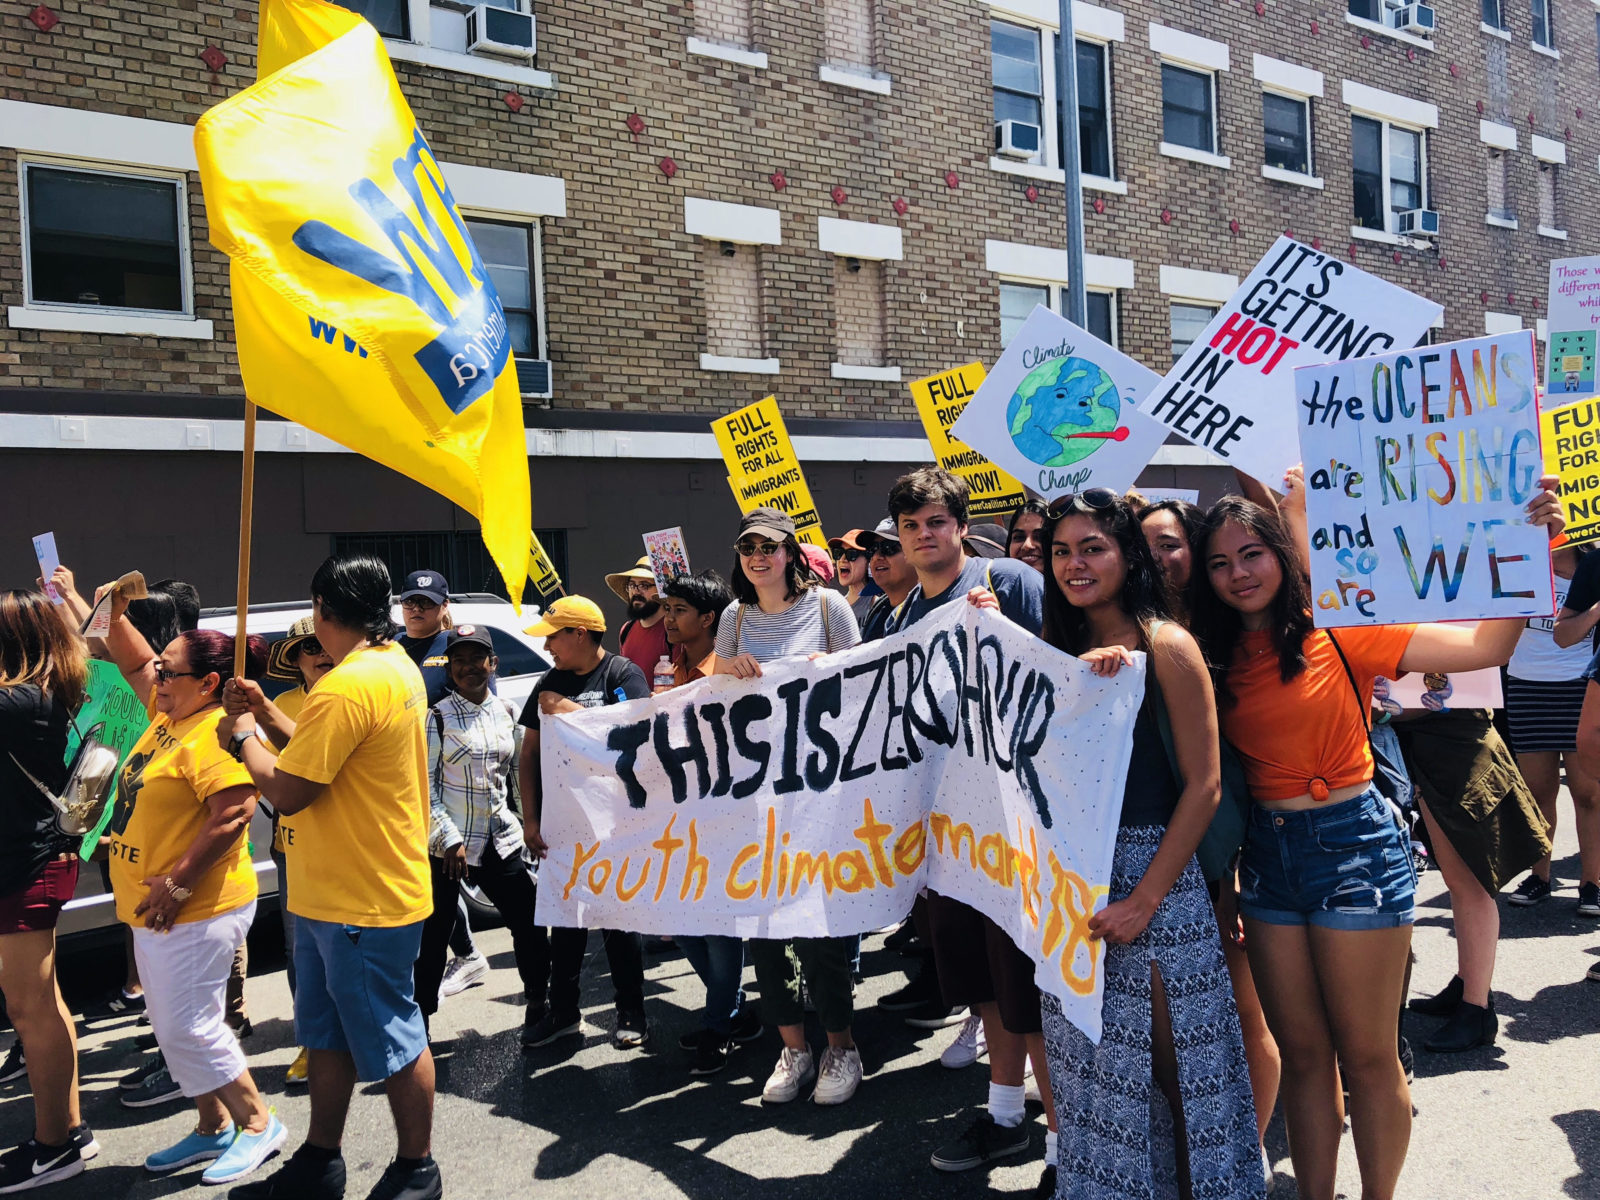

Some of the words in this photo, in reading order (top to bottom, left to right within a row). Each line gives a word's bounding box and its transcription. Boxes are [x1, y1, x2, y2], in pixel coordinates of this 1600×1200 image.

[1265, 242, 1344, 299] IT'S
[1556, 265, 1588, 278] Those
[1022, 338, 1075, 369] Climate
[1208, 312, 1300, 376] HOT
[1180, 347, 1234, 393] IN
[1302, 376, 1365, 428] the
[1372, 344, 1532, 424] OCEANS
[927, 372, 975, 405] FULL
[725, 407, 771, 441] FULL
[1150, 382, 1254, 458] HERE
[735, 430, 778, 460] RIGHTS
[741, 456, 764, 475] FOR
[766, 449, 785, 467] ALL
[941, 450, 988, 471] IMMIGRA
[1559, 450, 1599, 472] FOR
[740, 468, 800, 500] IMMIGRANTS
[1038, 467, 1093, 493] Change
[1310, 458, 1364, 498] are
[1374, 426, 1538, 506] RISING
[1311, 512, 1375, 551] and
[1335, 548, 1379, 578] so
[1393, 518, 1536, 603] WE
[1317, 579, 1376, 617] are
[606, 693, 773, 809] THIS
[773, 671, 842, 796] IS
[839, 629, 962, 783] ZERO
[954, 623, 1055, 830] HOUR
[562, 812, 710, 903] Youth
[724, 797, 927, 902] climate
